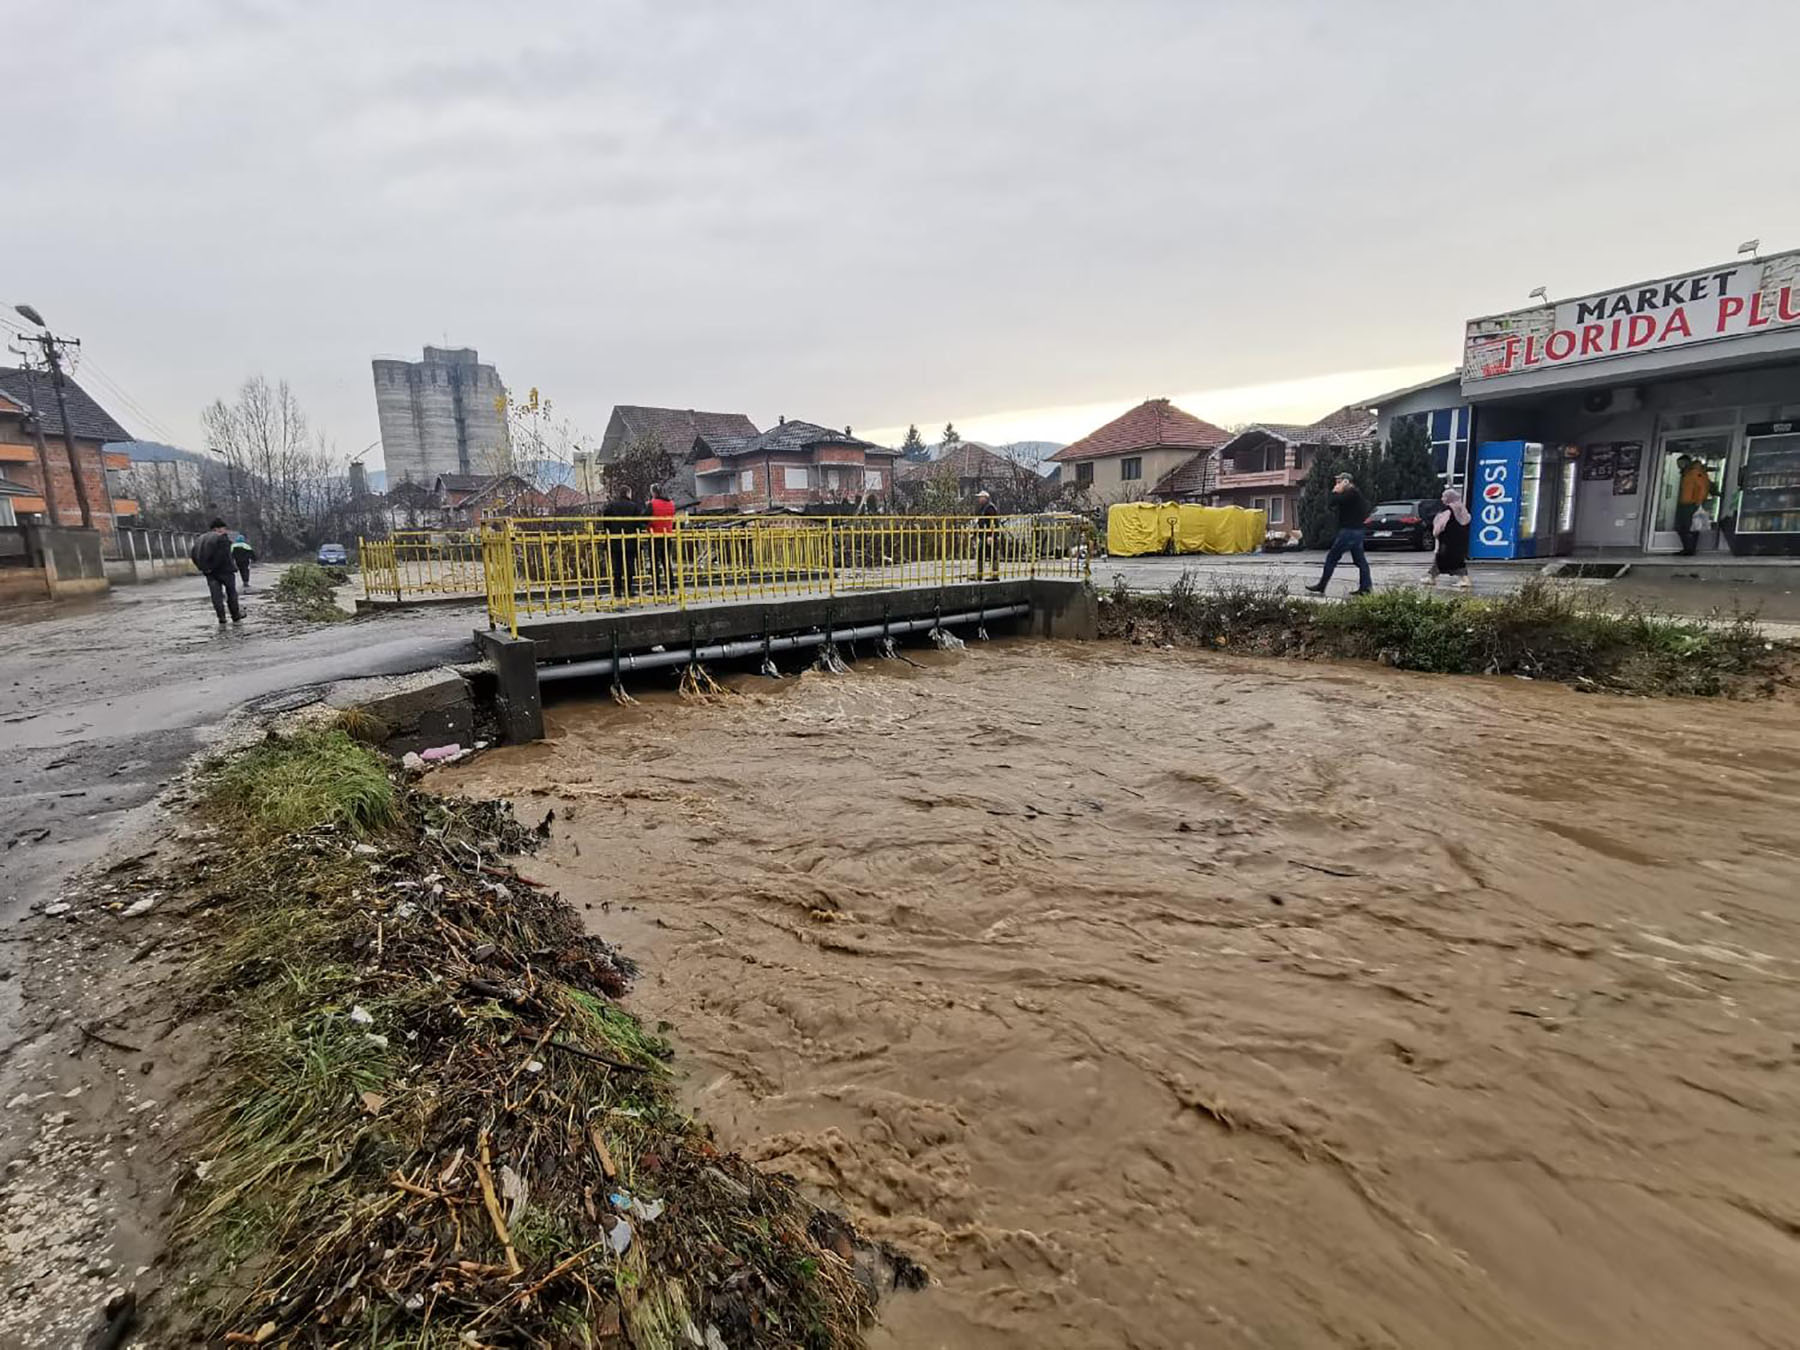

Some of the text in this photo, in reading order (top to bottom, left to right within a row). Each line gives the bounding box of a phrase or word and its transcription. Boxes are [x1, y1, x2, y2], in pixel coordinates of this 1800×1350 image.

[1576, 269, 1738, 324] MARKET
[1504, 306, 1692, 369] FLORIDA
[1479, 459, 1512, 546] pepsi
